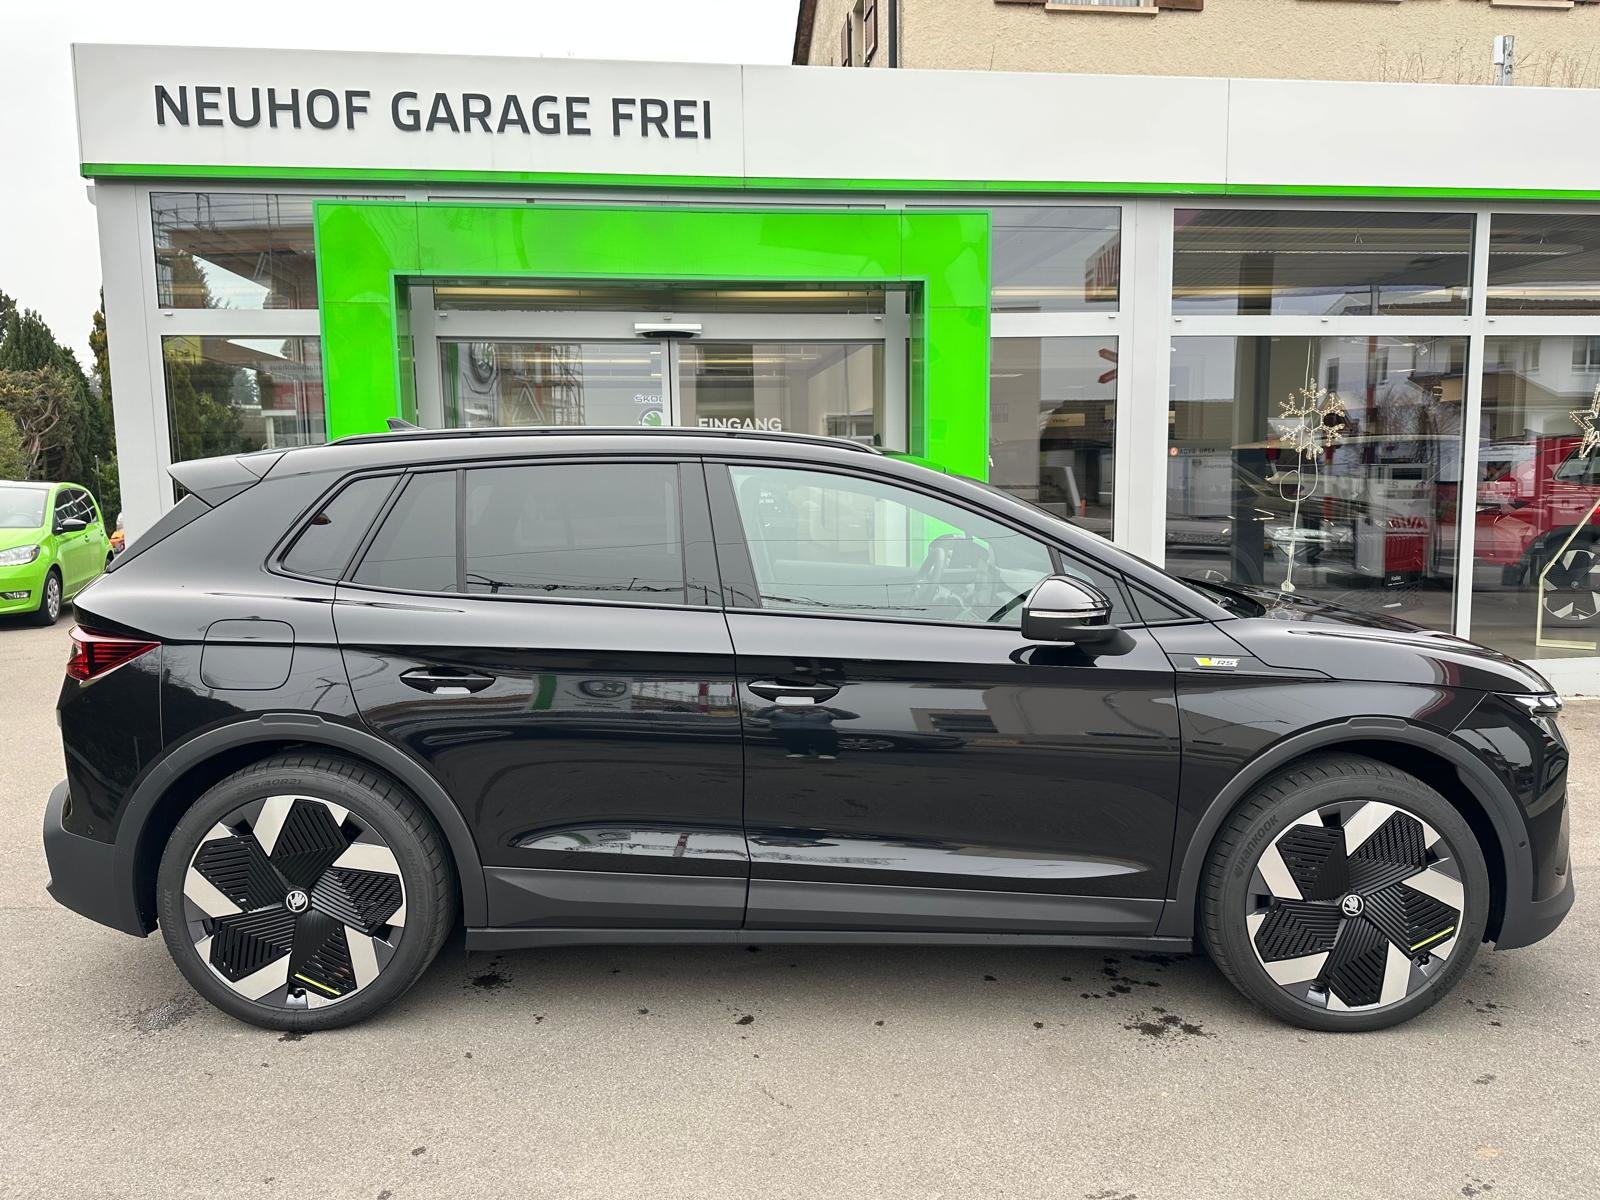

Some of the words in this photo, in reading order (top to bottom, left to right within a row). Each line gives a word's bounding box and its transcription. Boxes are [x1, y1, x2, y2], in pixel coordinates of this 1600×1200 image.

[154, 84, 371, 130] NEUHOF
[391, 91, 591, 135] GARAGE
[611, 97, 711, 139] FREI
[698, 417, 782, 432] EINGANG
